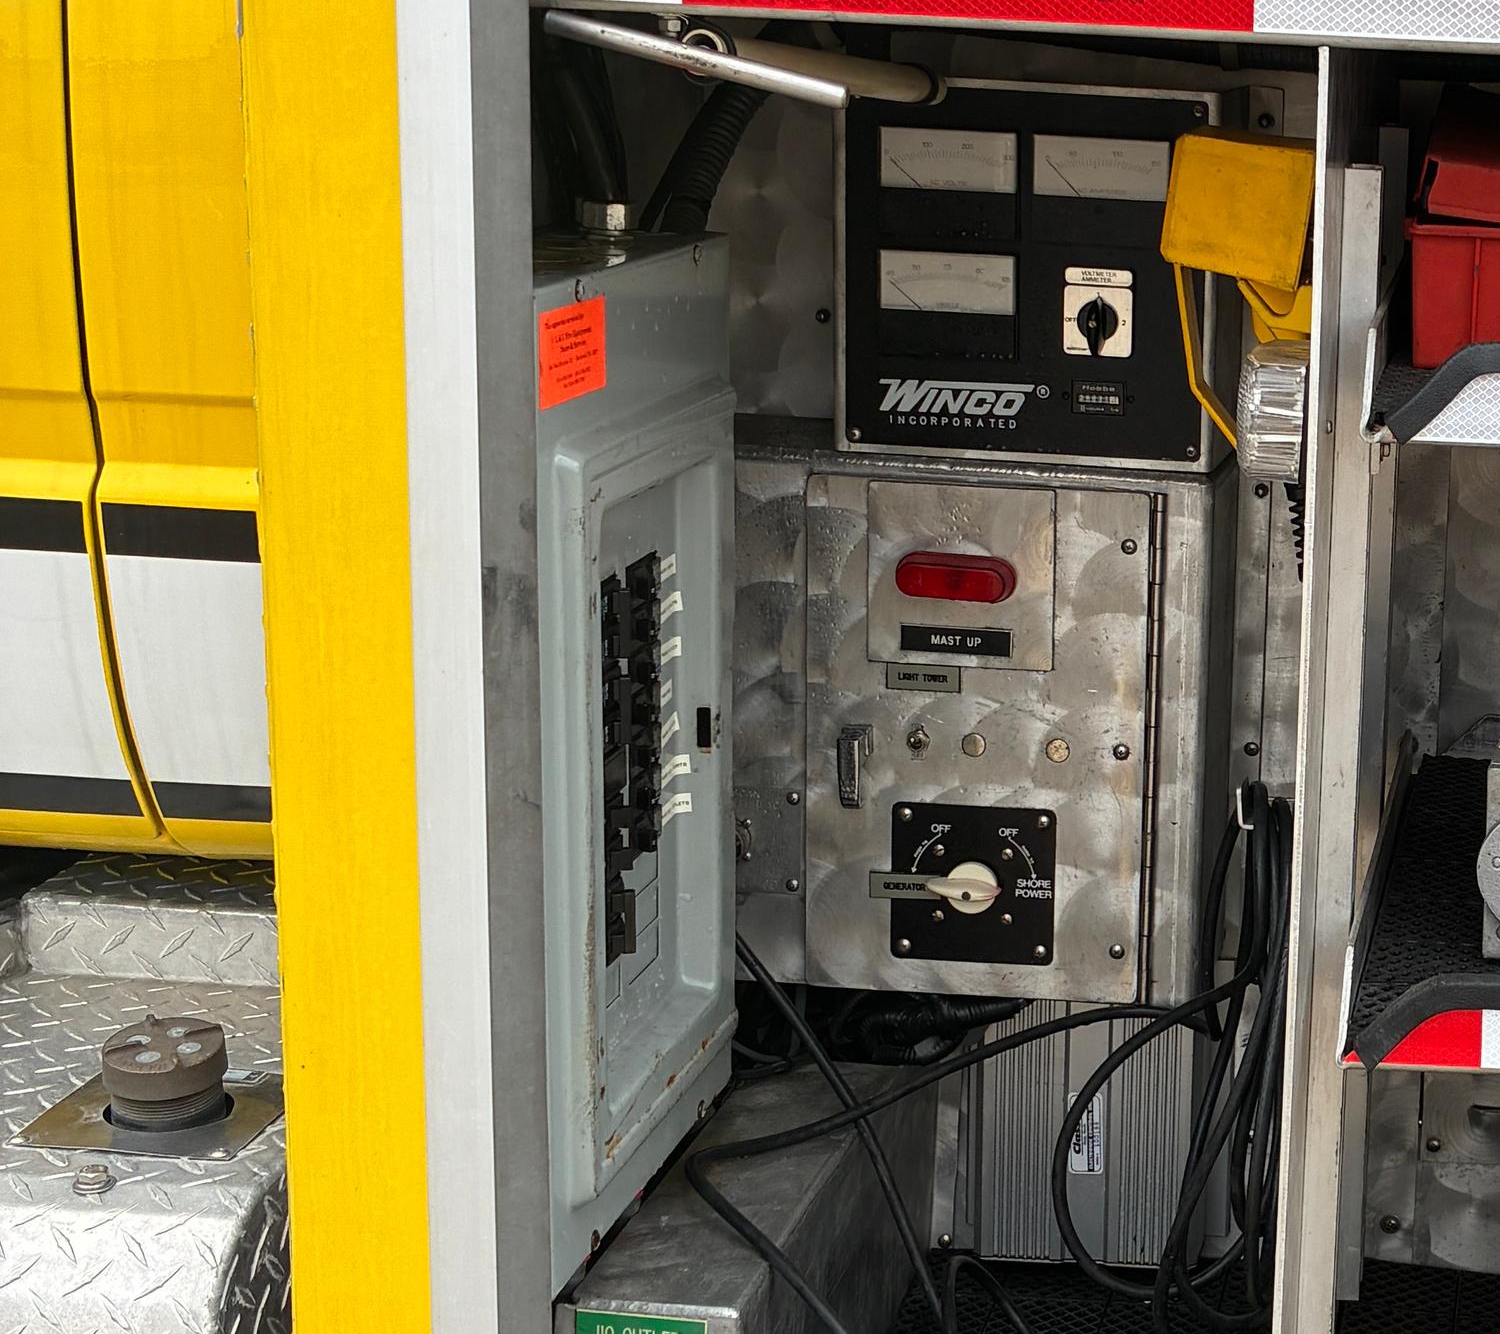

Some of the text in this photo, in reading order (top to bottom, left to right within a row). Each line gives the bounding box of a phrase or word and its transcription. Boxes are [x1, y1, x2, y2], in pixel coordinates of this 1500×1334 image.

[879, 379, 1035, 416] WINCO
[889, 415, 1017, 429] INCORPORATED
[930, 634, 982, 647] MAST UP
[897, 672, 948, 684] LIGHT TOWER
[930, 824, 951, 833] OFF
[998, 828, 1019, 837] OFF
[883, 882, 926, 891] GENERATOR
[1016, 878, 1051, 888] SHORE
[1015, 888, 1052, 899] POWER
